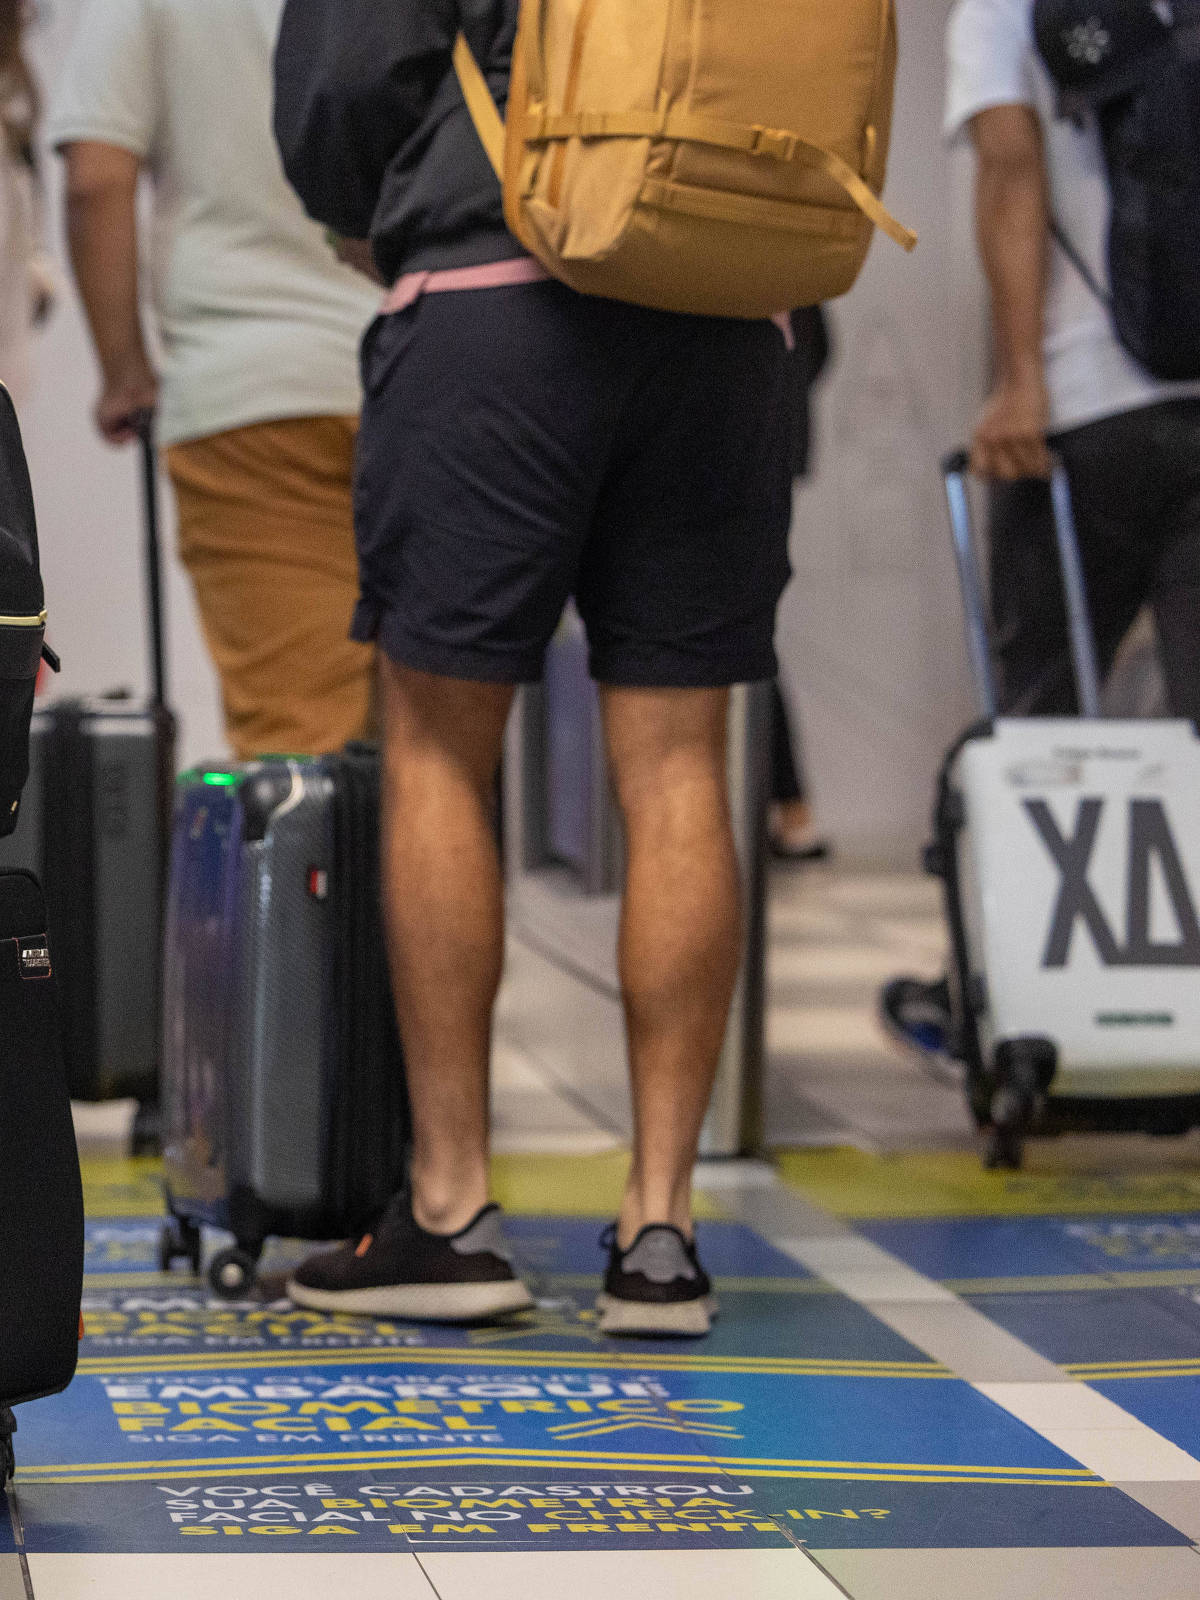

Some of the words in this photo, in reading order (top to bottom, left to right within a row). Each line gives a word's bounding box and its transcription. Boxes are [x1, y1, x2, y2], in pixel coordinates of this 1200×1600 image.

[105, 1383, 670, 1399] EMBARQUE
[117, 1415, 497, 1431] FACIAL
[126, 1433, 241, 1443] SIGA
[255, 1433, 324, 1443] EM
[339, 1433, 504, 1443] FRENTE
[156, 1482, 337, 1497] VOCÊ
[358, 1484, 755, 1496] CADASTROU
[165, 1498, 300, 1510] SUA
[320, 1497, 737, 1509] BIOMETRIA
[169, 1510, 392, 1523] FACIAL
[409, 1510, 522, 1522] NO
[544, 1508, 892, 1521] CHECK-IN?
[178, 1525, 361, 1536] SIGA
[386, 1523, 498, 1534] EM
[526, 1522, 782, 1533] FRENTE
